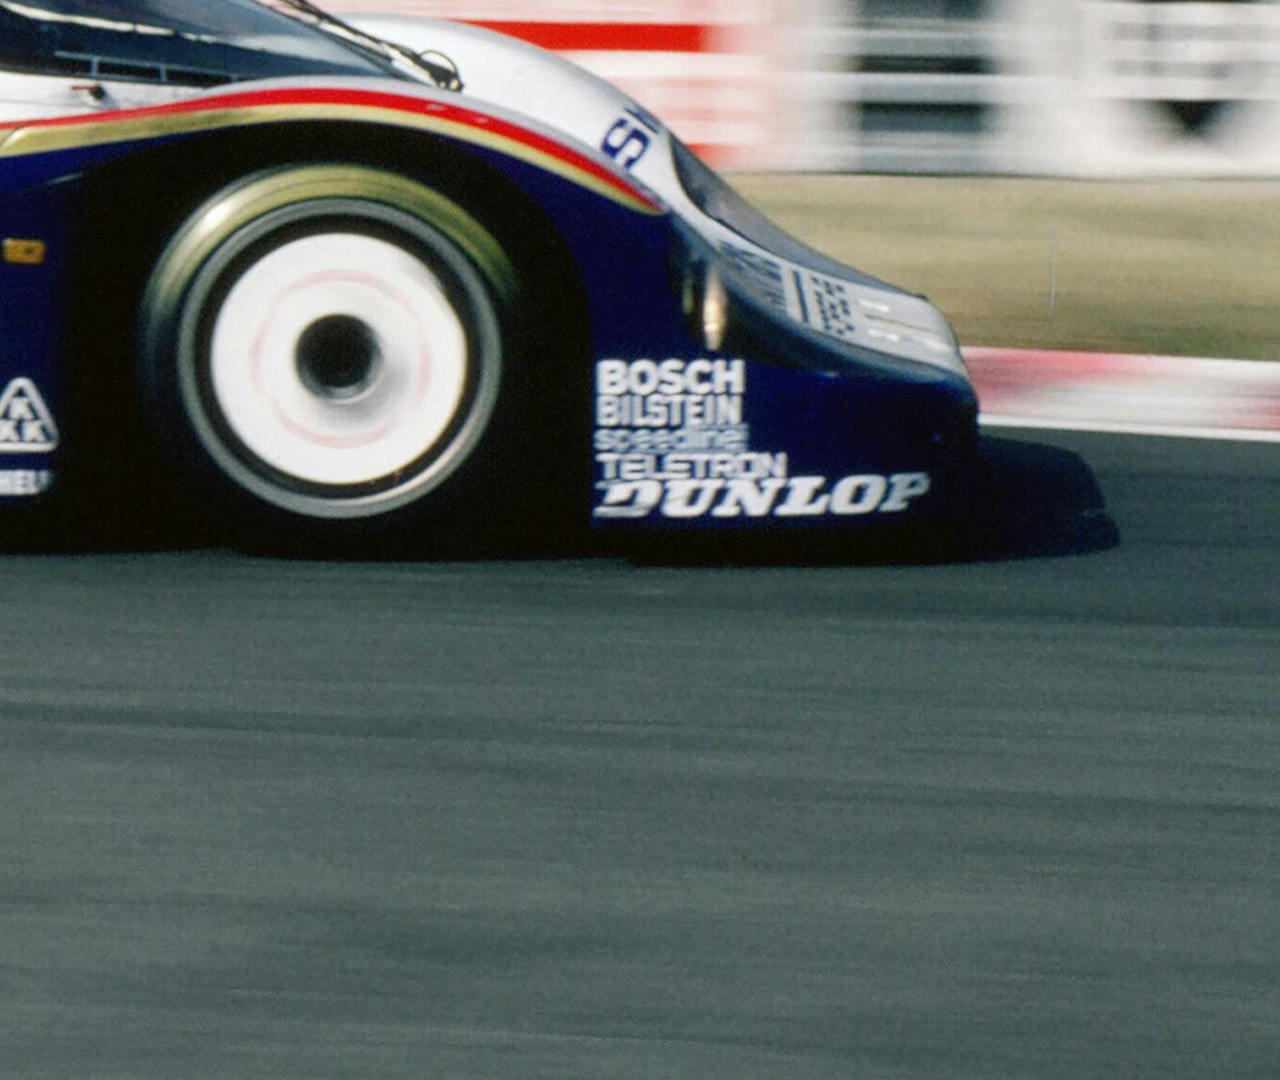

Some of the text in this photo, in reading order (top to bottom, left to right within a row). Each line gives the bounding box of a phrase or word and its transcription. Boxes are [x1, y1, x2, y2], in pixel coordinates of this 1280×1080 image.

[596, 359, 745, 394] BOSCH
[596, 394, 741, 426] BILSTEIN
[595, 452, 788, 478] TELETRON
[593, 474, 931, 517] DUNLOP
